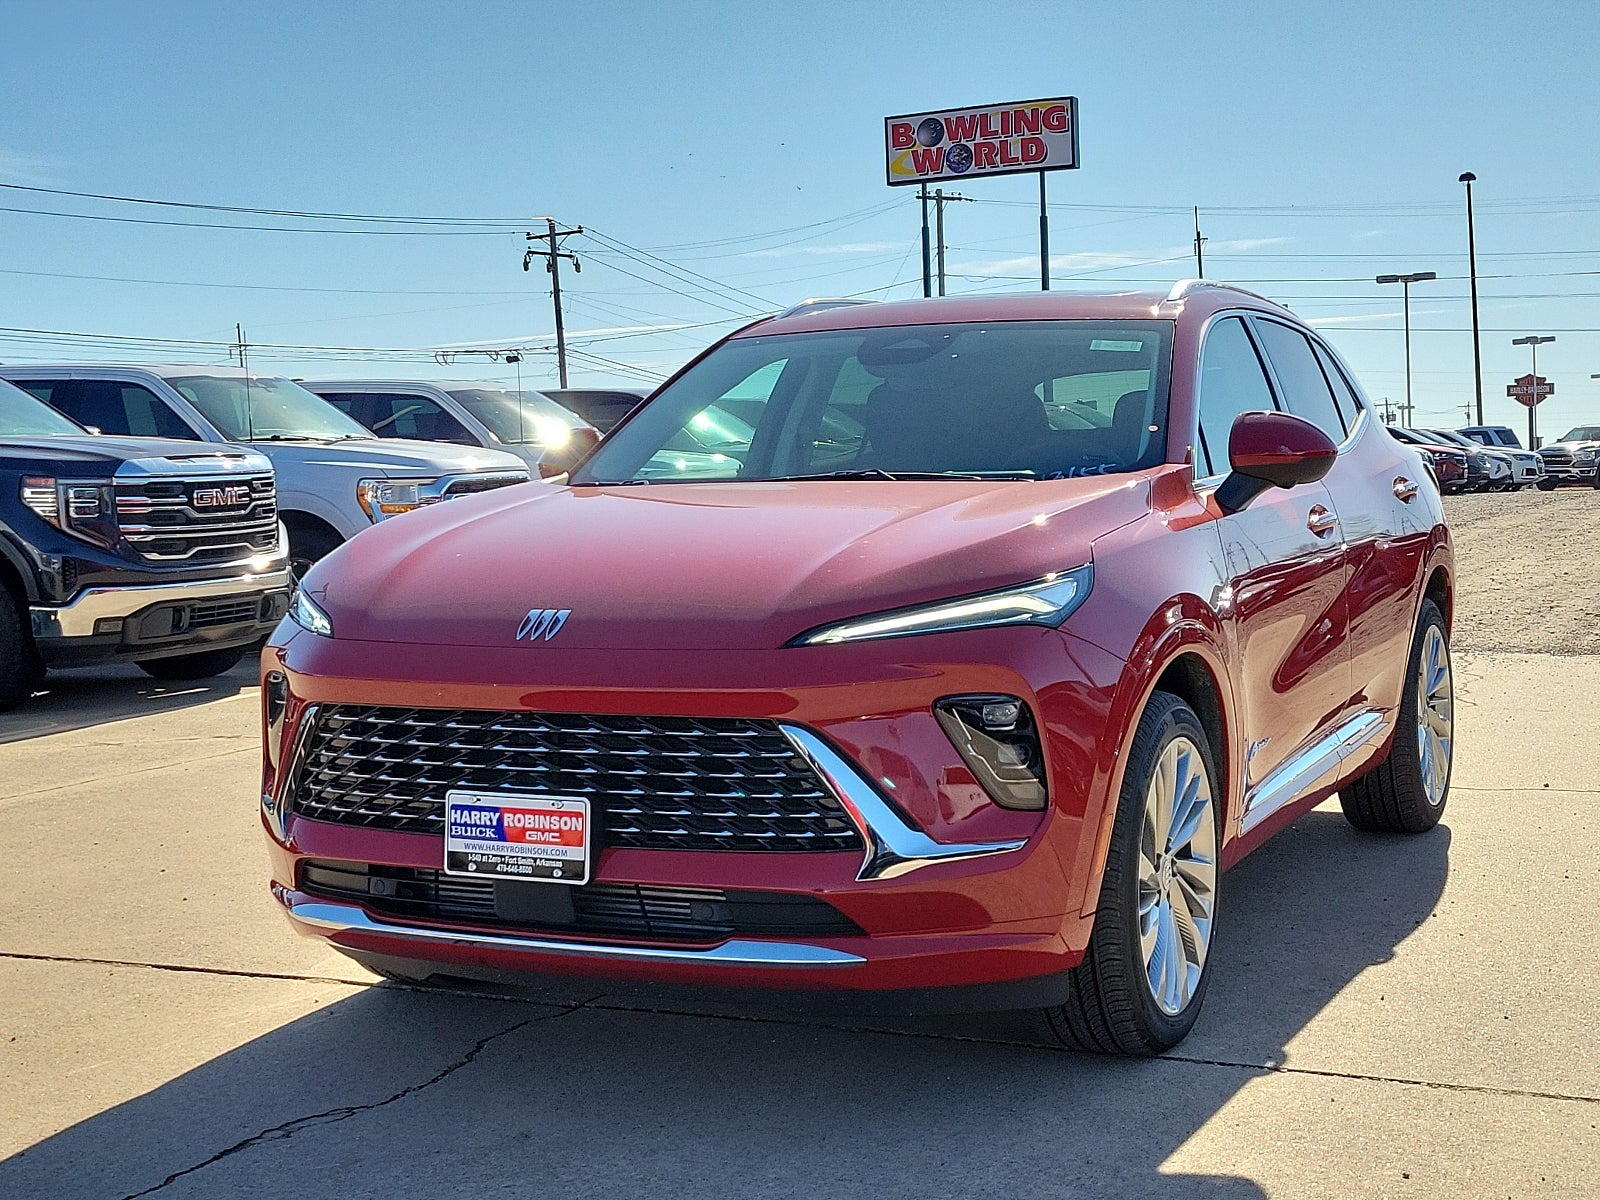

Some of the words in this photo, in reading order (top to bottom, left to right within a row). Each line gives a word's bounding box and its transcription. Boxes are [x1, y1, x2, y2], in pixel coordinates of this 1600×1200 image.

[891, 105, 1068, 149] BOWLING
[911, 136, 1048, 175] WORLD
[1509, 385, 1550, 394] HARLEY-DAIDSON
[193, 486, 250, 507] GMC
[450, 809, 500, 826] HARRY
[503, 813, 583, 831] ROBINSON
[450, 825, 498, 838] BUICK
[525, 831, 561, 842] GMC
[463, 842, 568, 857] WWW.HARRYROBINSON.COM
[505, 856, 517, 865] Fort
[536, 858, 563, 868] Arkansas
